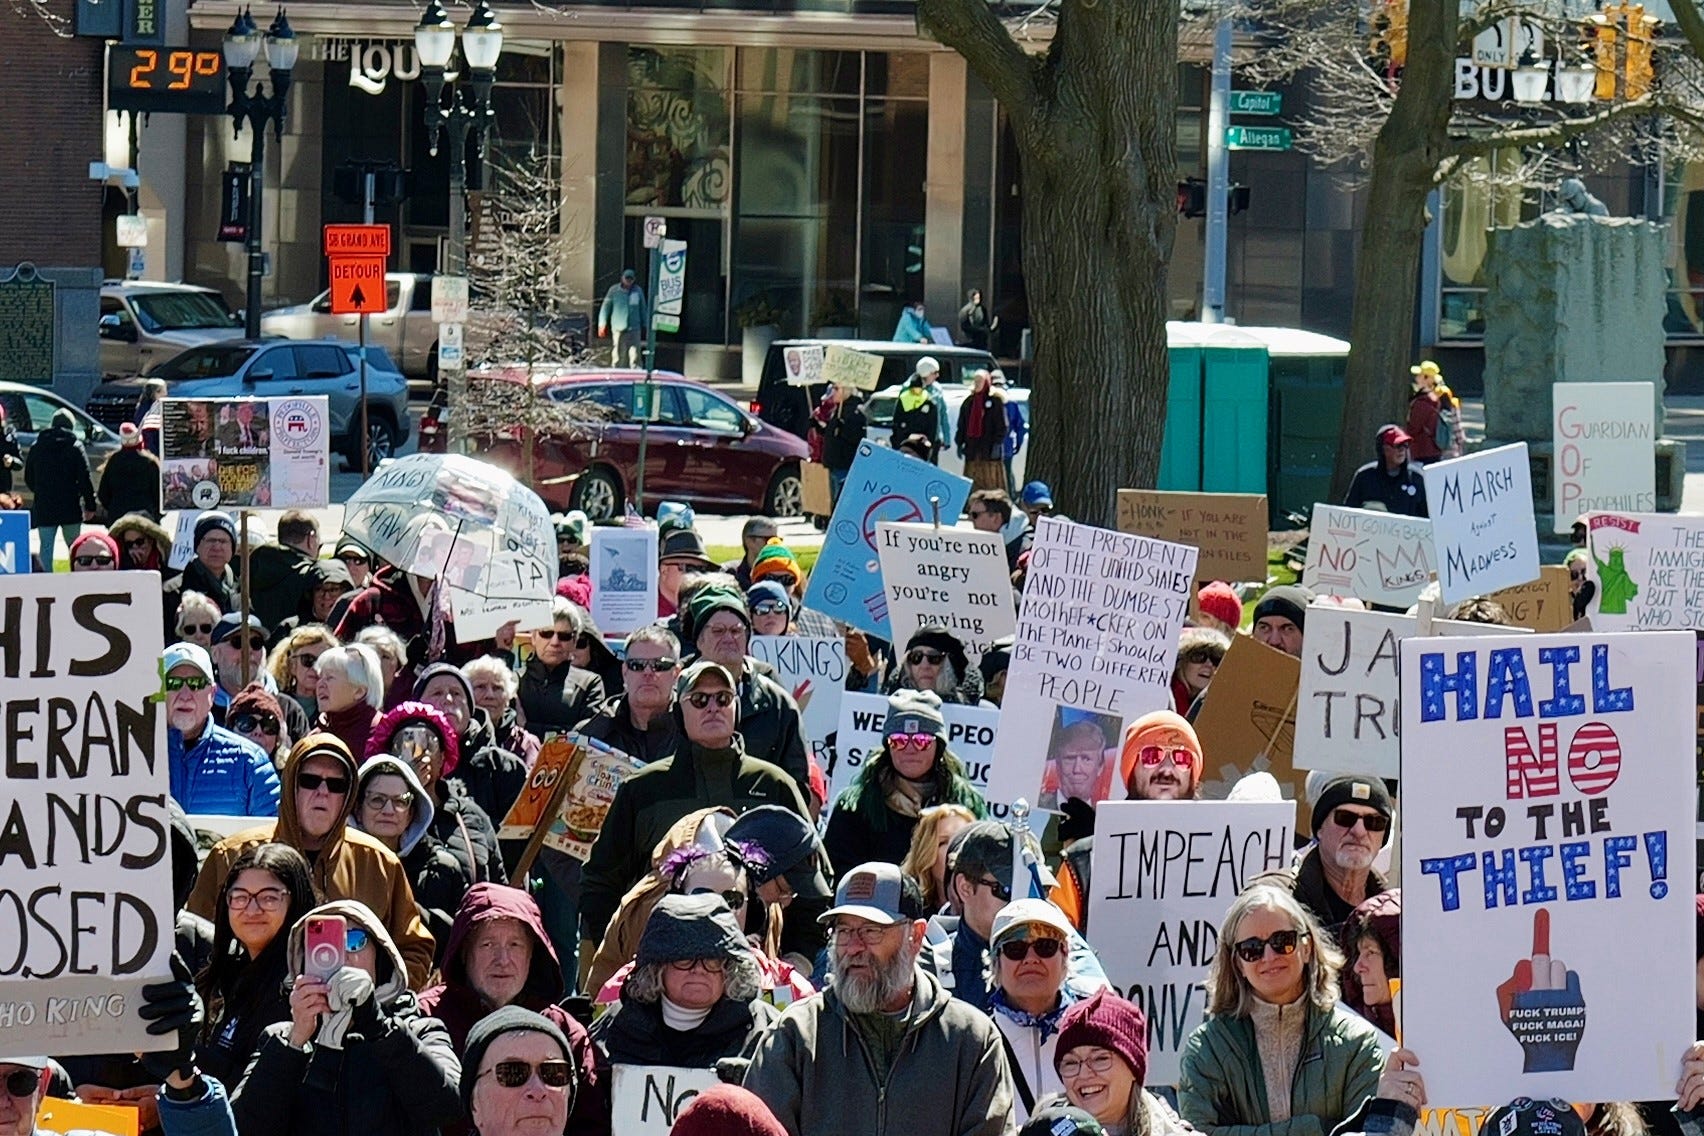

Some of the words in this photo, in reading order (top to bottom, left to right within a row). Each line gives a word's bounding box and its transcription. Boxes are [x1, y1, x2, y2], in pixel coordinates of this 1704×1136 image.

[1478, 51, 1505, 63] ONLY
[1238, 93, 1270, 112] Capitol
[1240, 128, 1280, 147] Allegan
[334, 265, 380, 280] DETOUR
[660, 277, 682, 291] BUS
[1558, 406, 1650, 440] GUARDIAN
[1560, 443, 1592, 478] OF
[863, 479, 892, 495] NO
[1440, 466, 1514, 516] MARCH
[1562, 482, 1655, 515] PEDOPHILES
[1181, 508, 1193, 521] IF
[1200, 510, 1218, 525] YOU
[1222, 512, 1248, 525] ARE
[1328, 512, 1357, 530] NOT
[1362, 518, 1400, 537] GOING
[1593, 515, 1634, 531] RESIST
[884, 529, 900, 548] If
[908, 535, 962, 553] you're
[968, 541, 999, 557] not
[1040, 520, 1082, 548] THE
[1091, 531, 1196, 571] PRESIDENT
[1180, 528, 1200, 538] NOT
[1206, 530, 1217, 540] IN
[1223, 530, 1248, 541] THE
[1031, 548, 1059, 570] OF
[1063, 550, 1095, 576] THE
[1218, 551, 1251, 562] FILES
[1318, 543, 1357, 572] NO
[917, 560, 970, 584] angry
[1384, 569, 1425, 587] KINGS
[1650, 570, 1676, 588] ARE
[892, 583, 950, 602] you're
[968, 589, 999, 607] not
[1026, 572, 1066, 599] AND
[1071, 575, 1097, 600] THE
[1103, 583, 1187, 622] DUMBEST
[1646, 588, 1677, 608] BUT
[917, 612, 985, 635] paying
[1636, 606, 1672, 627] WHO
[1143, 620, 1168, 641] ON
[776, 640, 845, 682] KINGS
[1014, 644, 1036, 663] BE
[1045, 649, 1083, 672] TWO
[1038, 672, 1126, 712] PEOPLE
[1420, 644, 1635, 723] HAIL
[853, 710, 885, 733] WE
[1504, 721, 1622, 800] NO
[1455, 805, 1507, 840] TO
[1526, 797, 1612, 841] THE
[1105, 824, 1287, 900] IMPEACH
[1419, 829, 1670, 912] THIEF!
[1147, 920, 1218, 967] AND
[46, 996, 125, 1025] KING
[1509, 1008, 1540, 1019] FUCK
[1512, 1021, 1544, 1032] FUCK
[1546, 1019, 1584, 1030] MAGA!
[1519, 1033, 1551, 1043] FUCK
[1554, 1032, 1578, 1042] ICE!
